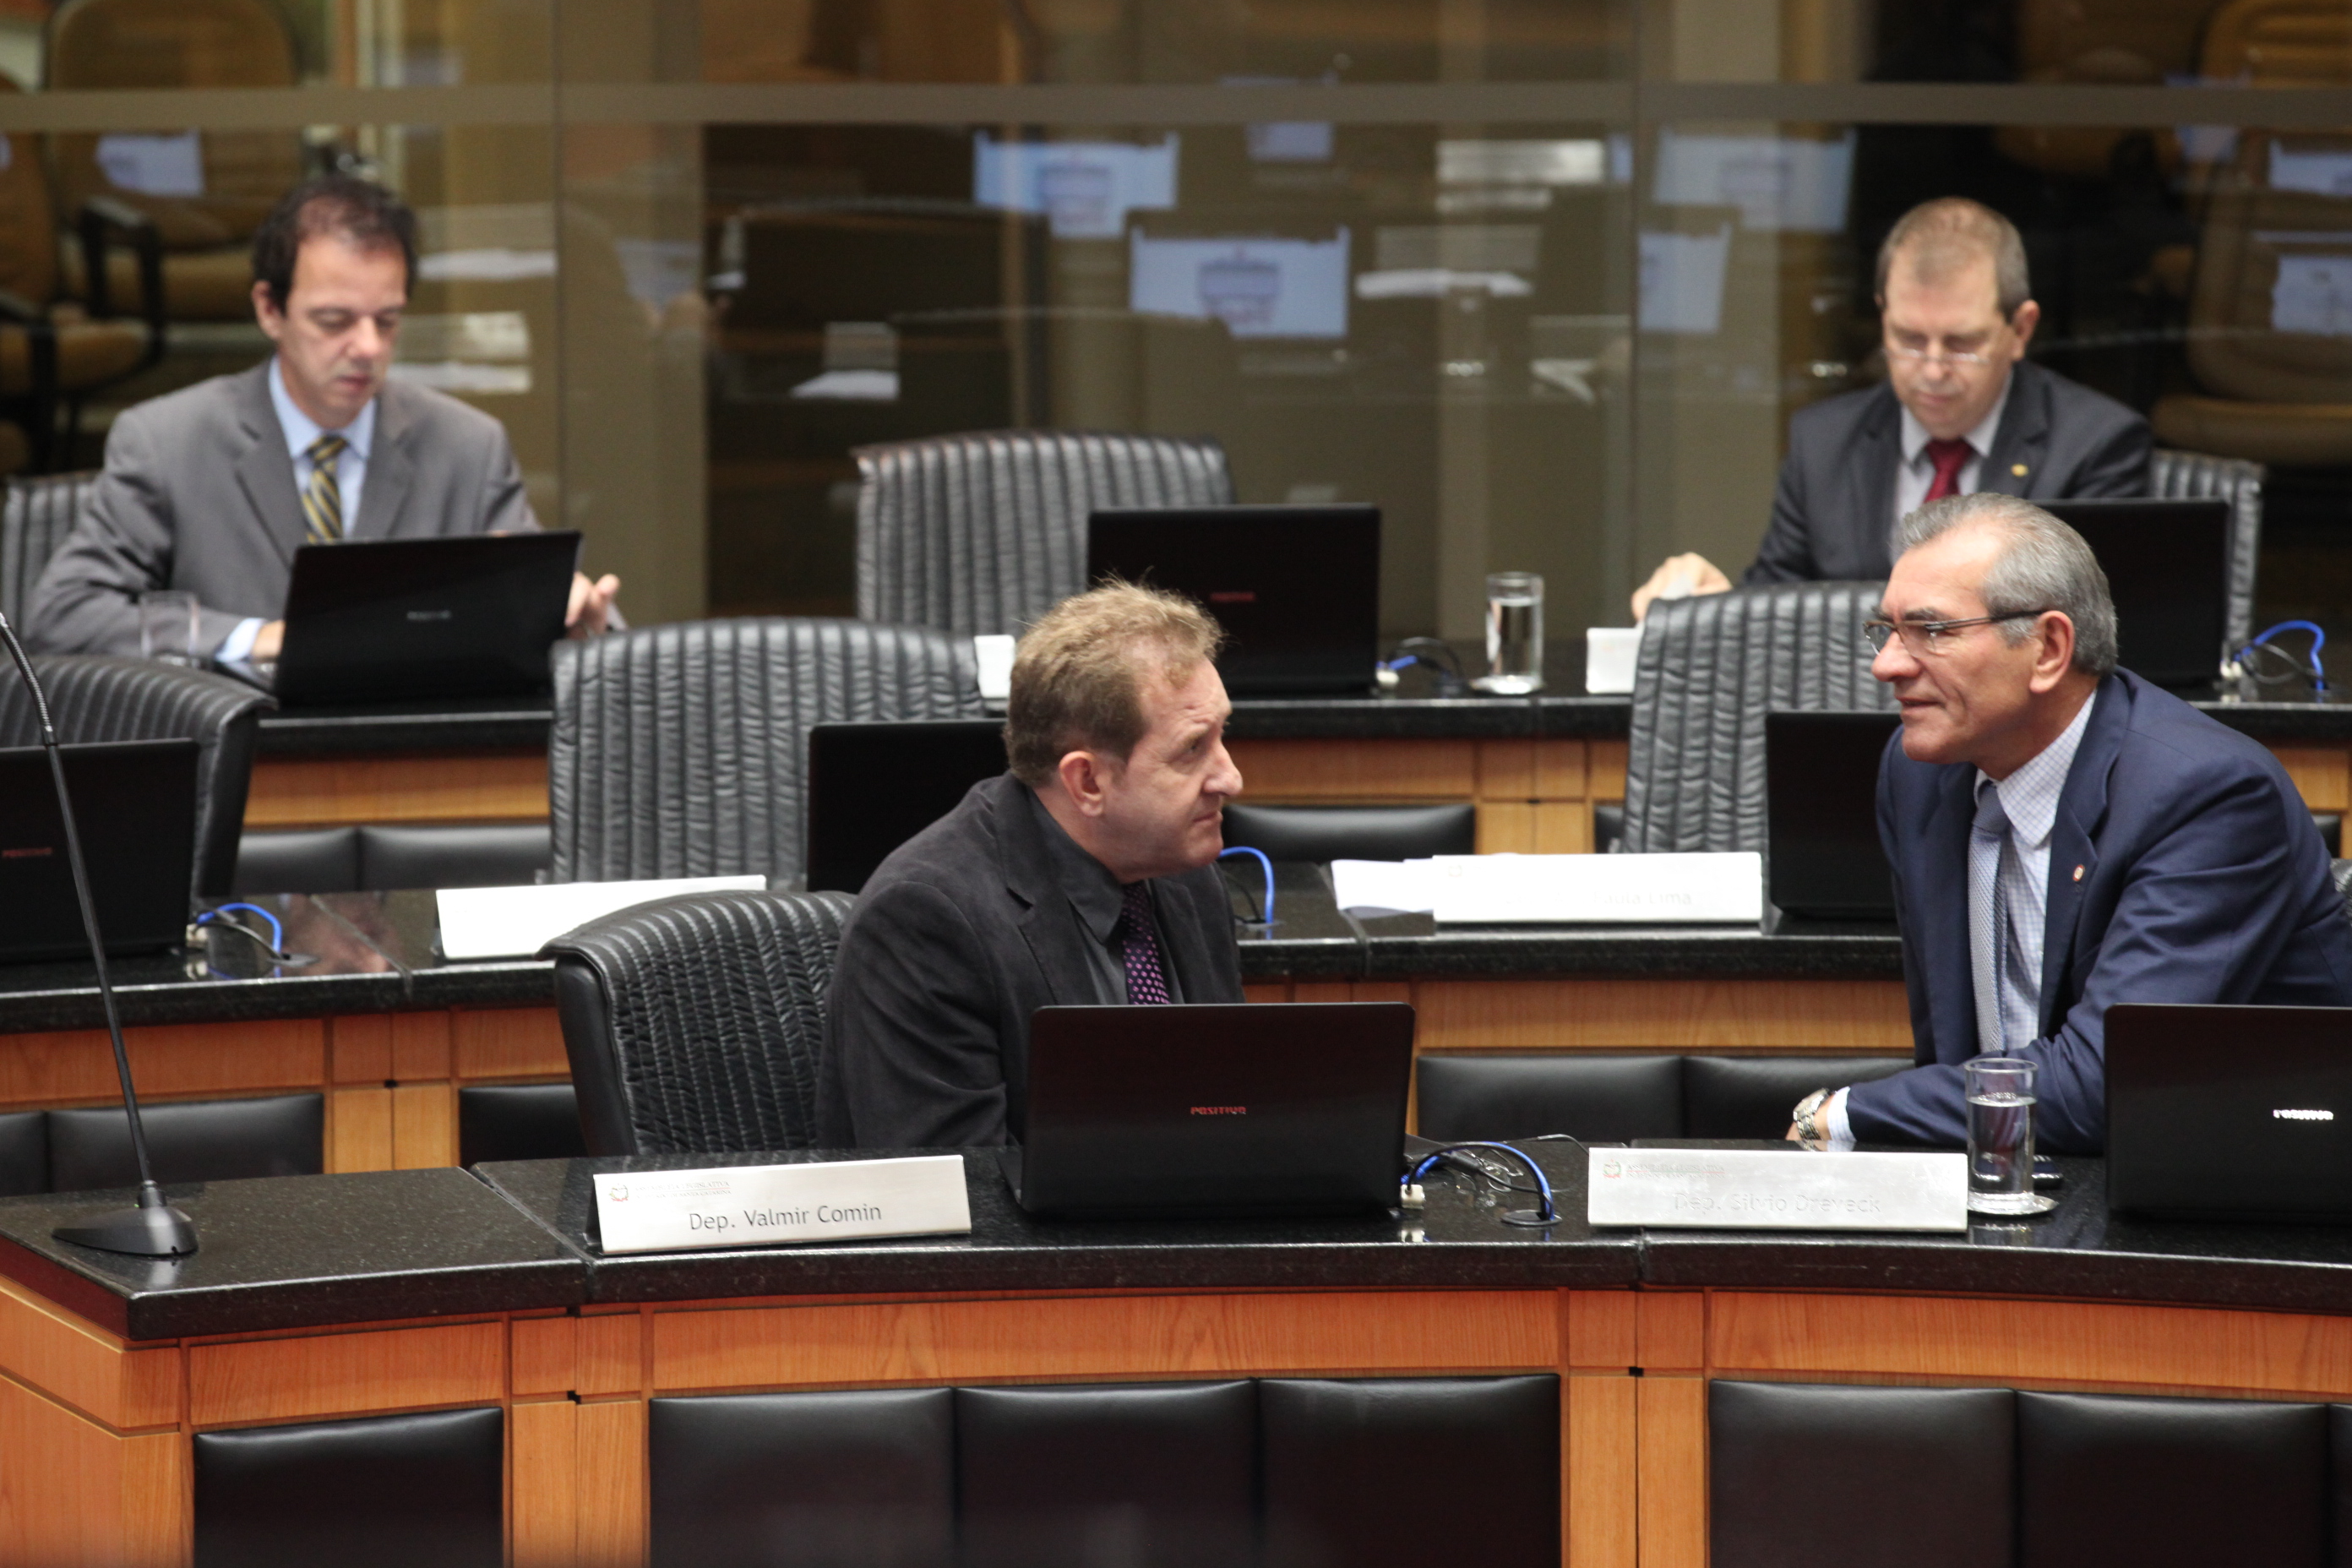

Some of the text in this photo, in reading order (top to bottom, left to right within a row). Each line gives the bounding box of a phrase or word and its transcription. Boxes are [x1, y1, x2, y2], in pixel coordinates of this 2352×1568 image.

[1674, 1192, 1881, 1215] Dep. Silvio Dreveck
[689, 1203, 882, 1233] Dep. Valmir Comin
